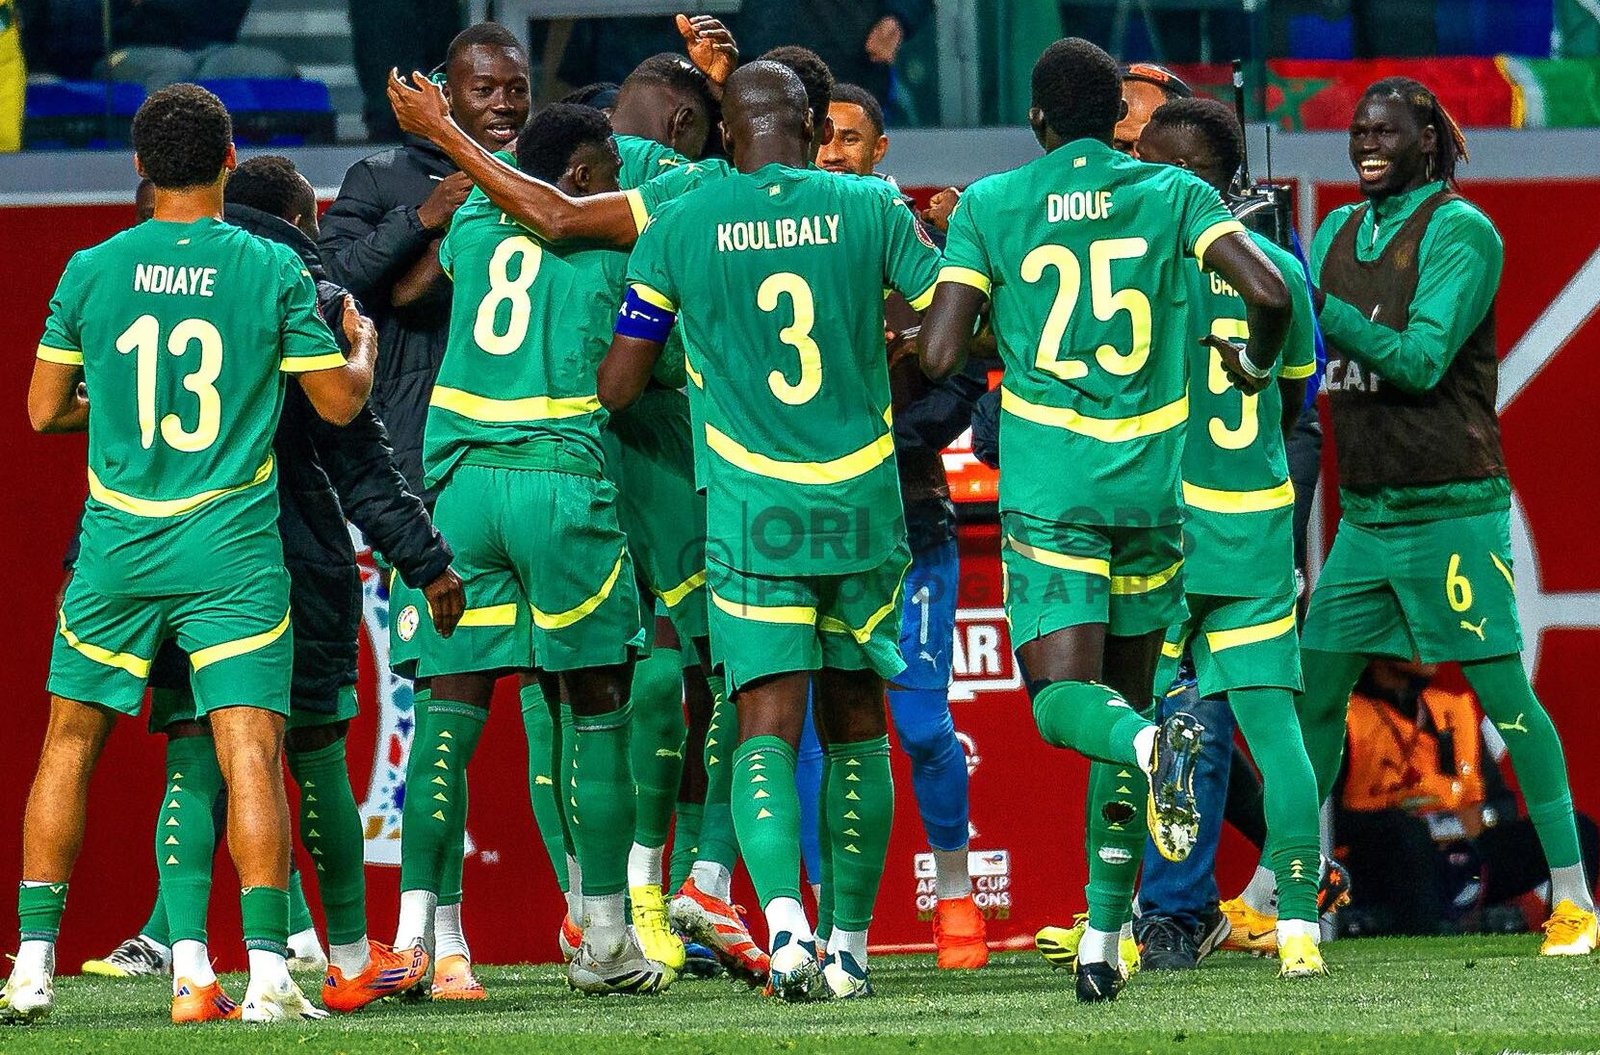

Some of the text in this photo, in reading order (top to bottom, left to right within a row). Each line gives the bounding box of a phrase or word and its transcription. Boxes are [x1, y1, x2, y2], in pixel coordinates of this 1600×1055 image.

[717, 214, 839, 251] KOULIBALY
[1047, 190, 1113, 222] DIOUF
[134, 263, 218, 297] NDIAYE
[473, 235, 543, 356] 8
[1020, 236, 1152, 380] 25
[757, 271, 823, 406] 3
[115, 313, 224, 453] 13
[1207, 317, 1260, 451] 5
[1446, 553, 1473, 612] 6
[911, 586, 930, 645] 1
[976, 877, 1008, 891] CUP
